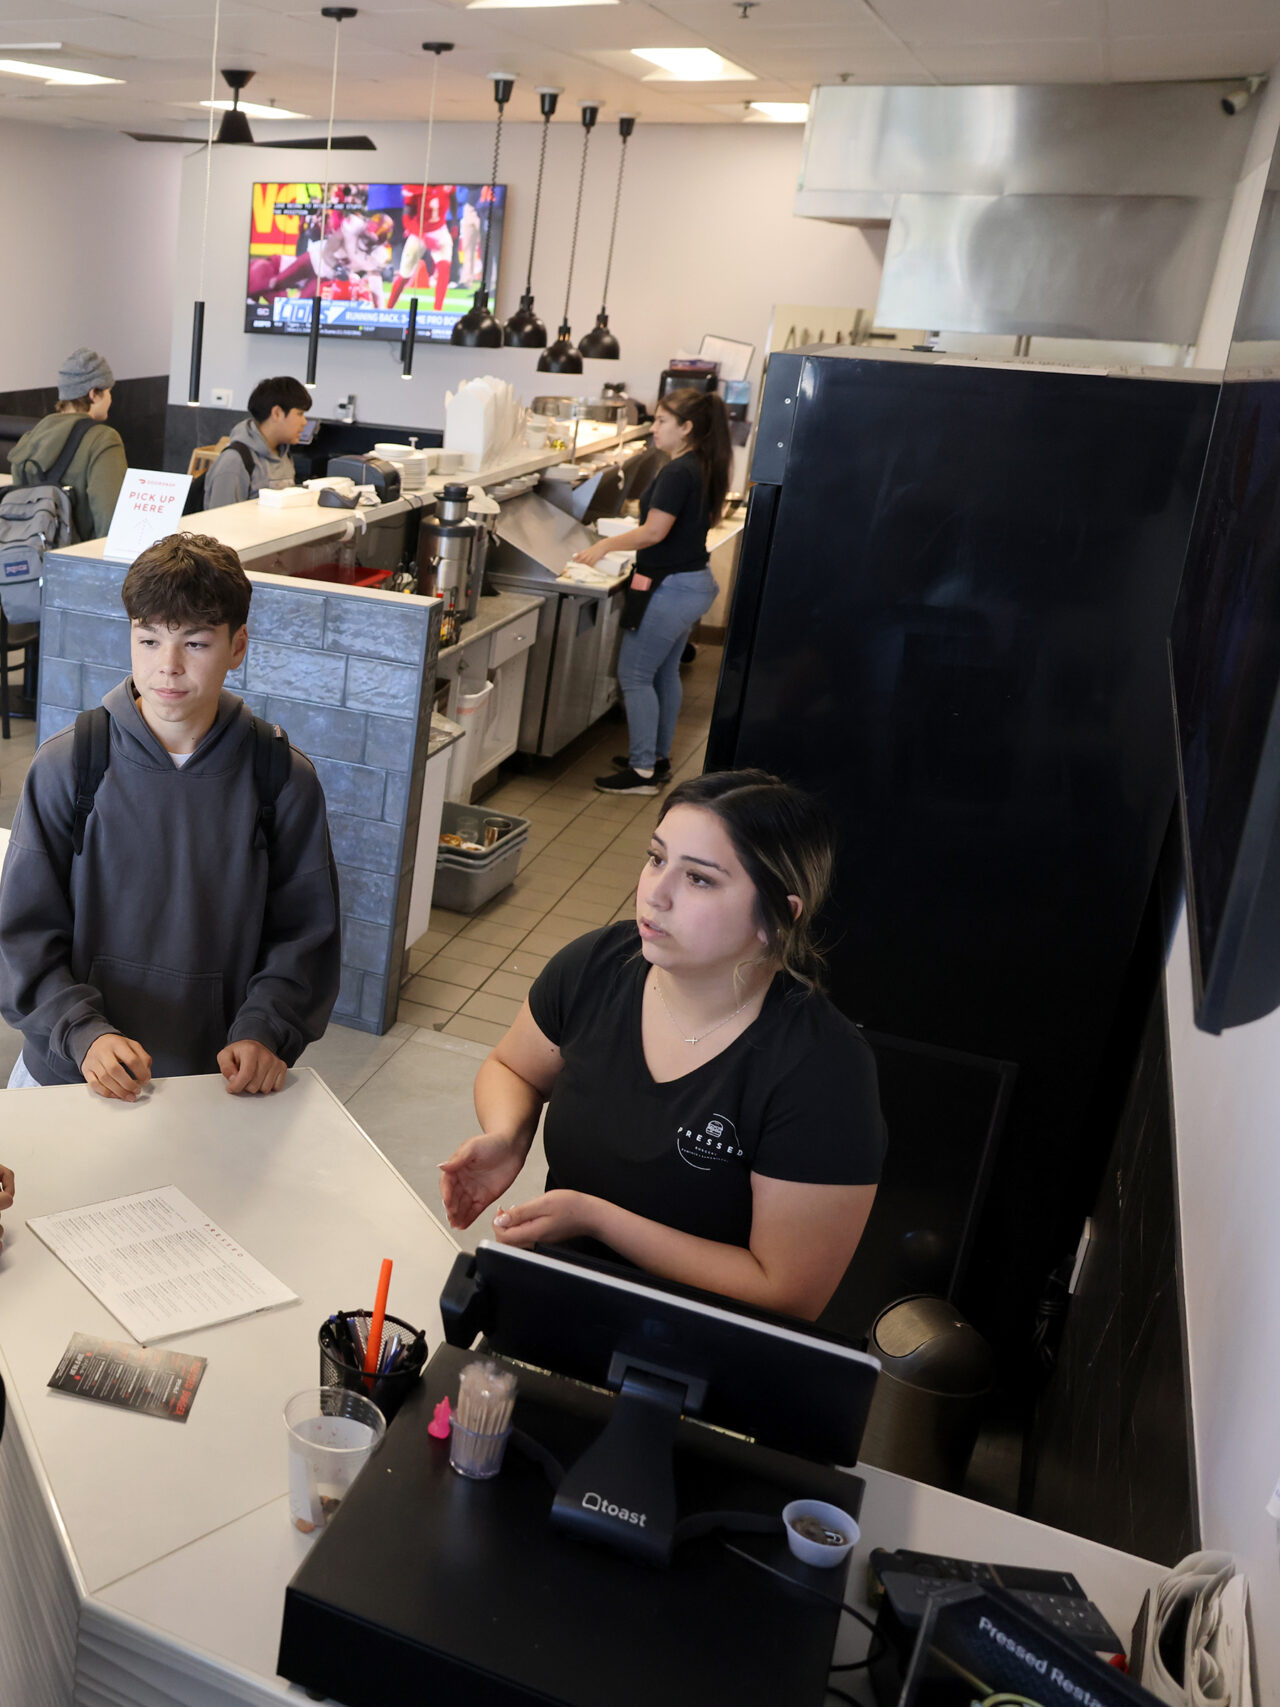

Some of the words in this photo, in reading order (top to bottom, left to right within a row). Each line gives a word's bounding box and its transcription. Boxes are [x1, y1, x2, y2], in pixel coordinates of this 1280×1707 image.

[345, 311, 378, 322] RUNNING
[129, 491, 155, 502] PICK
[160, 495, 176, 503] UP
[133, 503, 165, 514] HERE
[677, 1126, 744, 1157] PRESSED
[600, 1499, 647, 1528] toast
[978, 1615, 1049, 1675] Pressed
